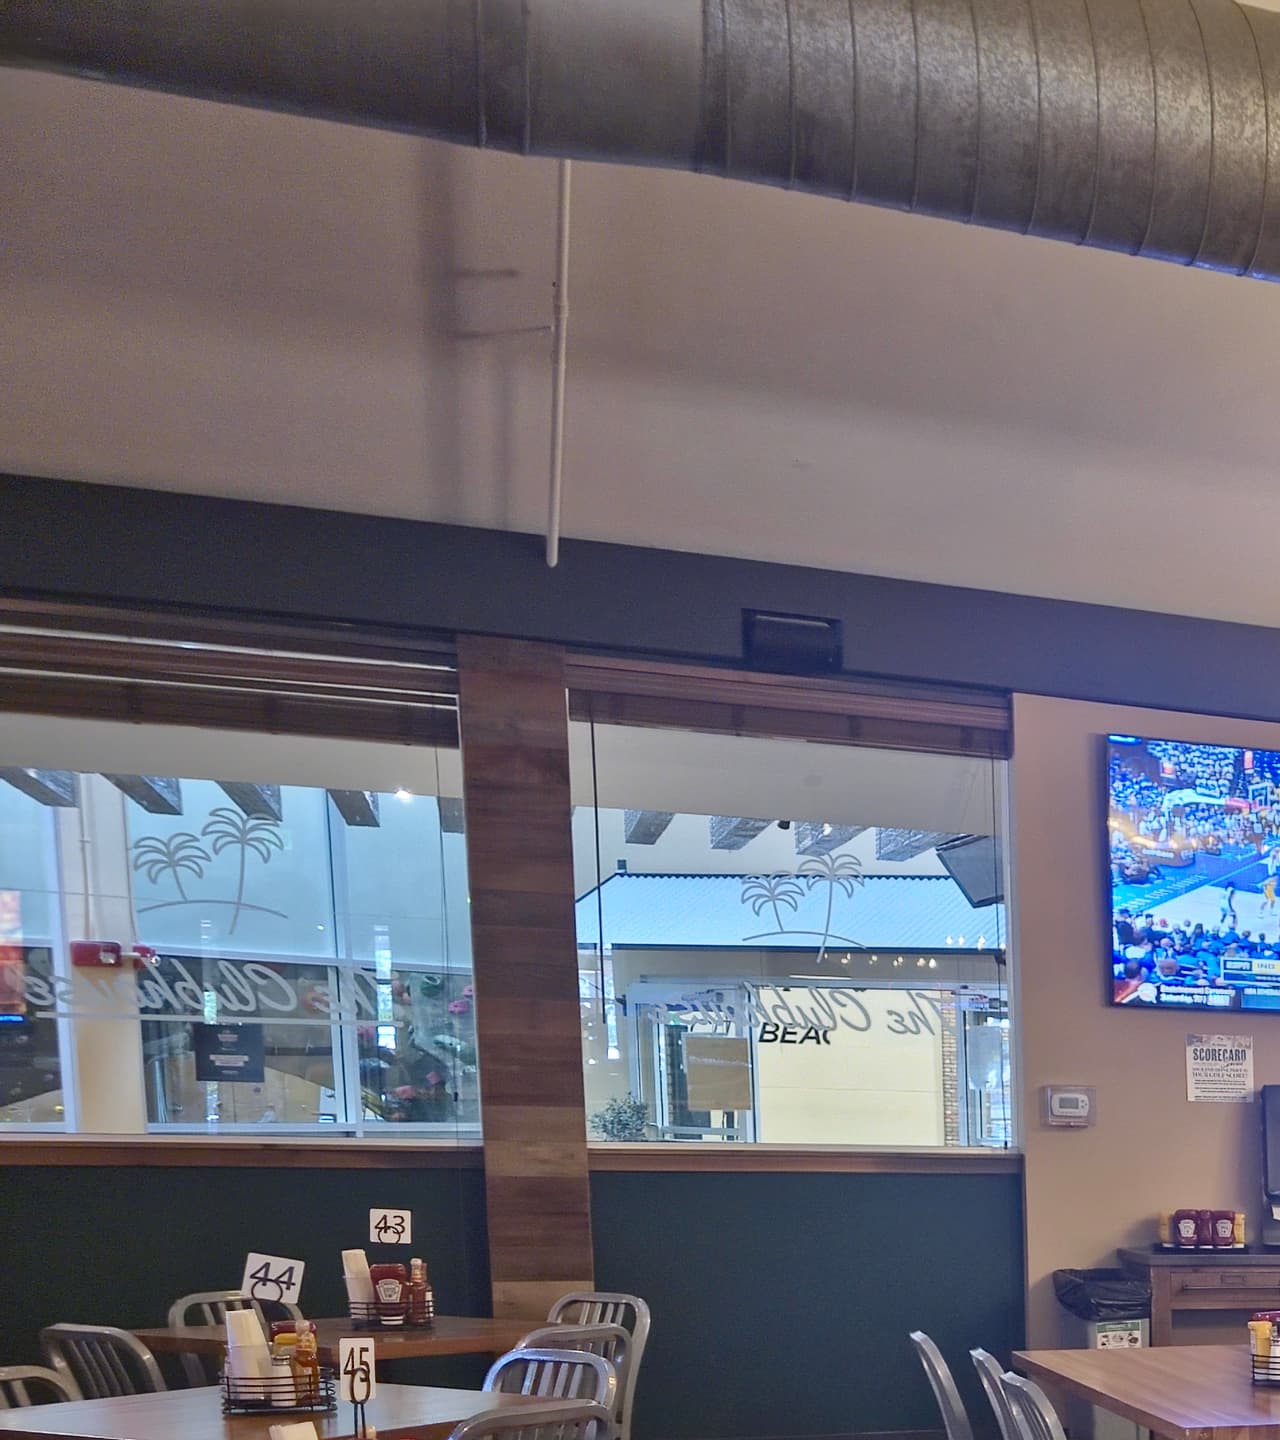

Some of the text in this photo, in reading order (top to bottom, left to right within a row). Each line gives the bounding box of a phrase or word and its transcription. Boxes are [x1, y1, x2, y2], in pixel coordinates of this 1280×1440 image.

[1192, 1047, 1247, 1062] SCORECARD
[374, 1214, 406, 1235] 43
[250, 1261, 297, 1291] 44
[343, 1346, 371, 1383] 45
